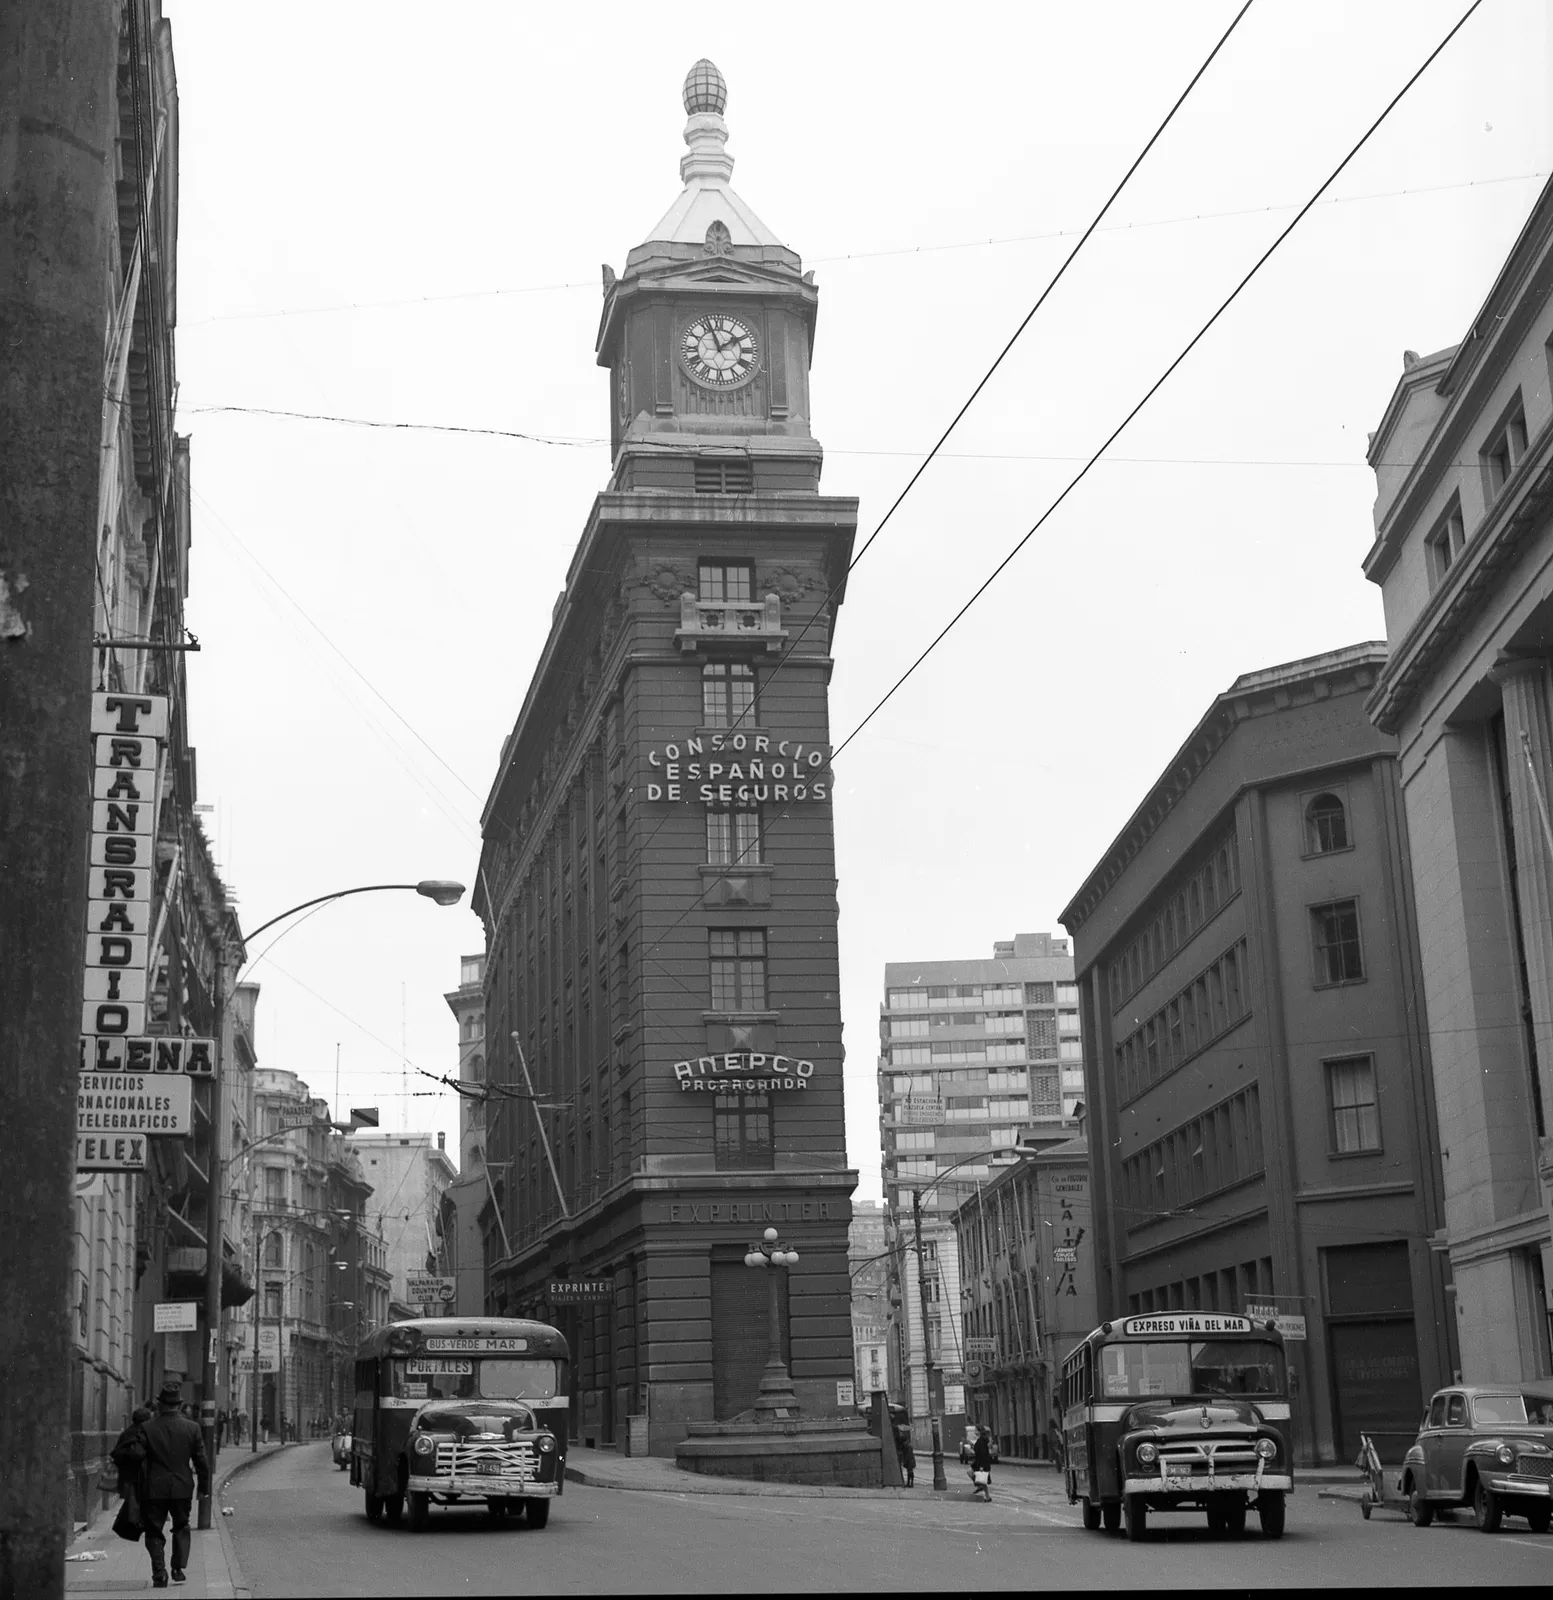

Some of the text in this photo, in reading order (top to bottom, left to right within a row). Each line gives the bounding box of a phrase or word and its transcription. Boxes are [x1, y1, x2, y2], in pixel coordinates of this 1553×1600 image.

[649, 734, 822, 767] CONSORCIO
[667, 759, 805, 780] ESPAÑOL
[648, 783, 826, 801] DE SEGUROS
[96, 696, 152, 1033] TRANSRADIO
[674, 1053, 814, 1080] ANEPCO
[78, 1113, 178, 1129] TELEGRAFICOS
[670, 1203, 830, 1223] EXPRINTER
[1063, 1227, 1078, 1296] ITLIA
[408, 1279, 443, 1287] VALPARAISO
[412, 1287, 439, 1295] COUNTRY
[550, 1282, 612, 1293] EXPRINTER
[1133, 1318, 1244, 1332] EXPRESO VIÑA DEL MAR
[429, 1339, 516, 1350] BUS-VERDE MAR
[410, 1359, 469, 1374] PORTALES
